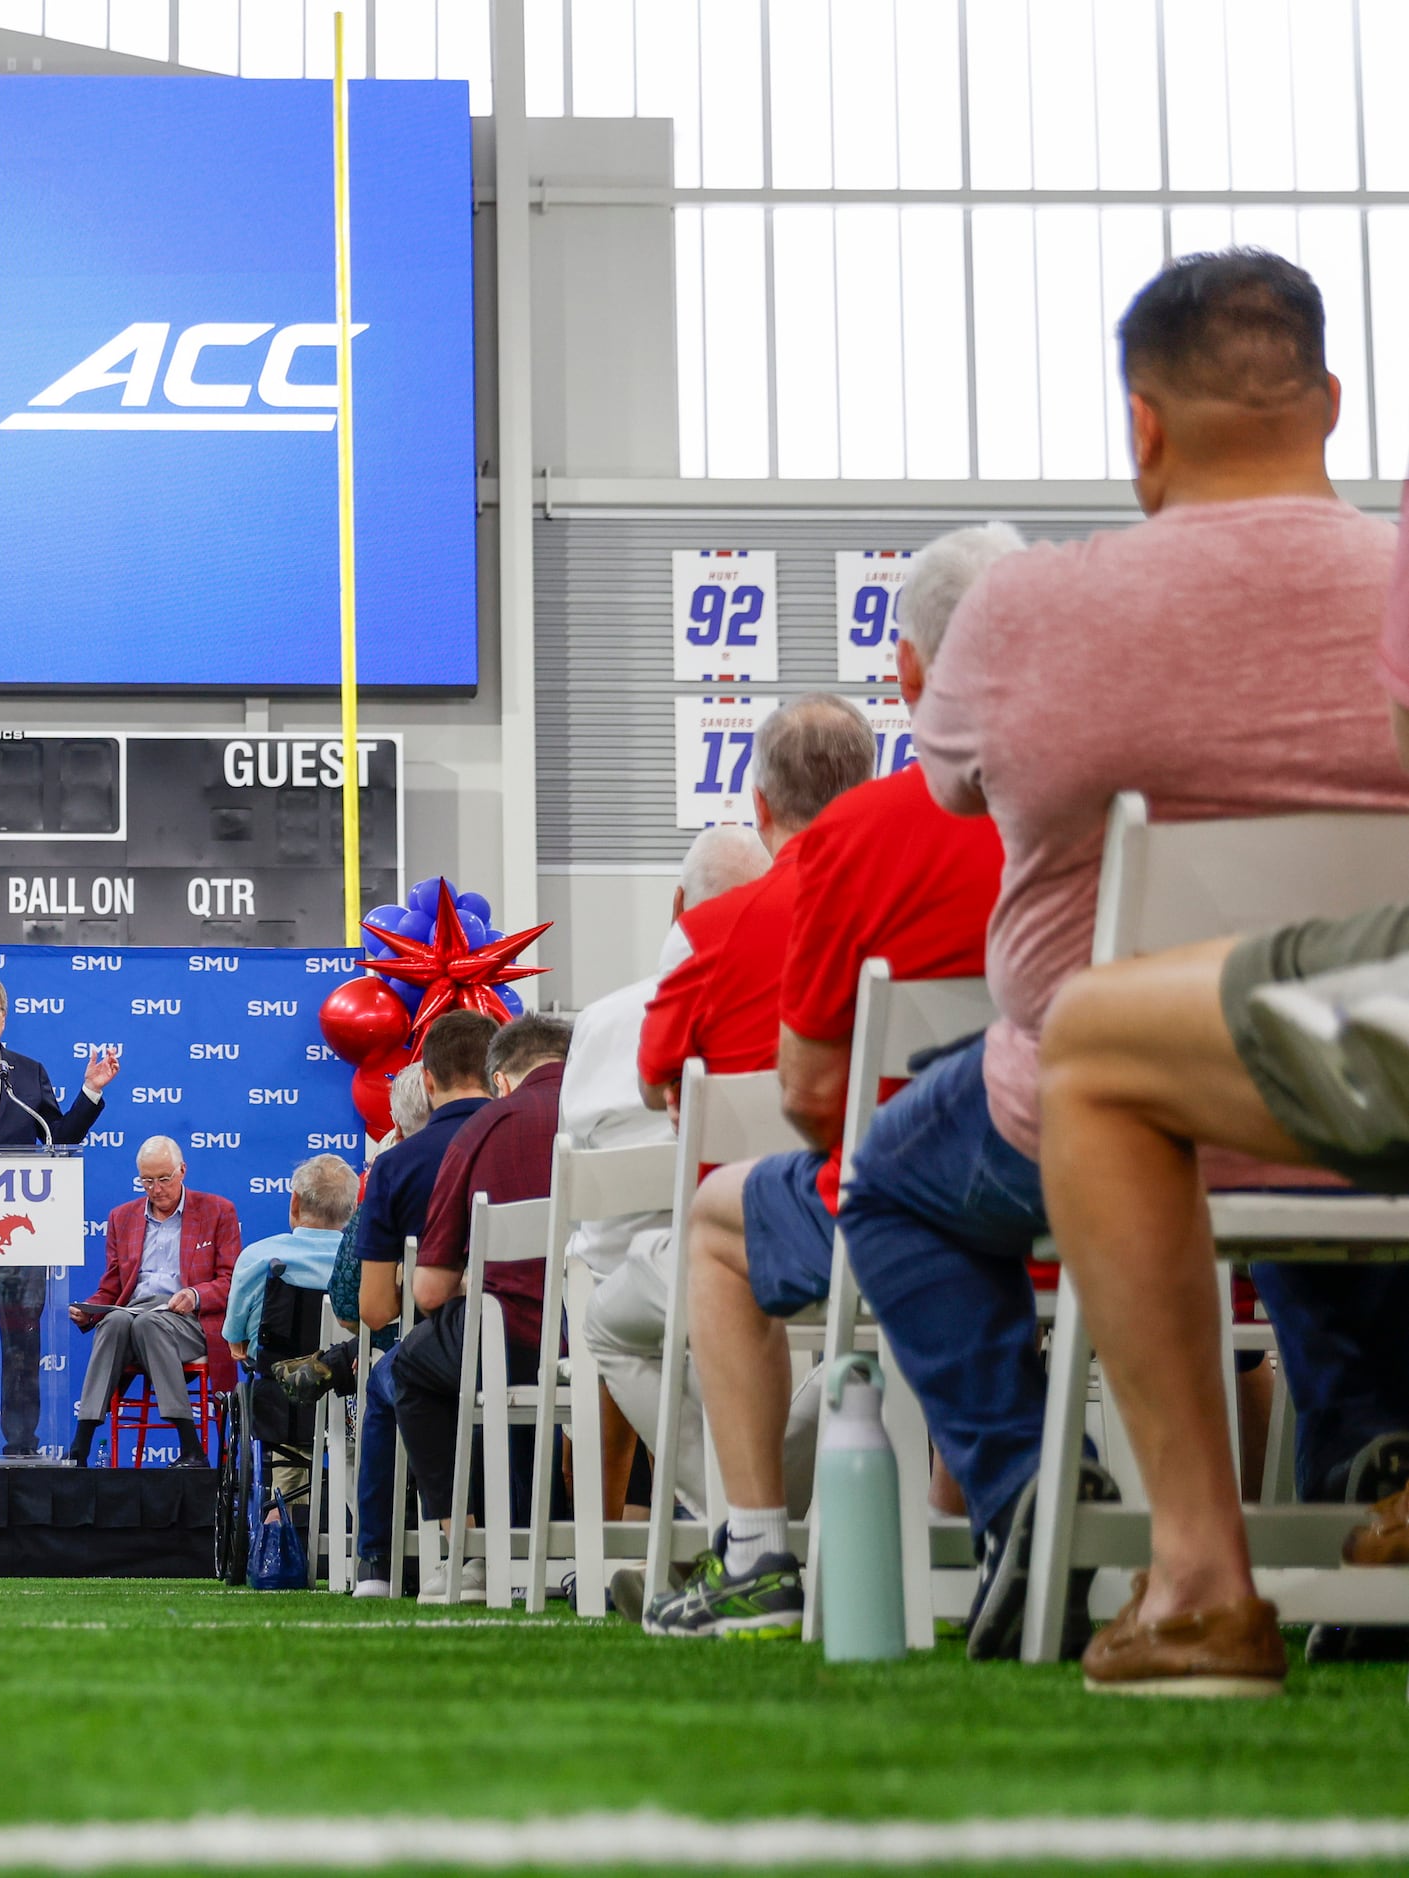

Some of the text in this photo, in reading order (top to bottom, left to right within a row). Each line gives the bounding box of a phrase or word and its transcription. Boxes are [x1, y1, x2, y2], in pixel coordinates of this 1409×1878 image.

[27, 322, 371, 407] ACC
[709, 571, 739, 581] HUNT
[686, 585, 764, 646] 92
[850, 586, 901, 647] 9
[700, 718, 753, 728] SANDERS
[224, 740, 377, 788] GUEST
[694, 732, 755, 794] 17
[8, 877, 134, 915] BALL ON
[187, 877, 256, 918] QTR
[72, 956, 122, 971] SMU
[189, 956, 239, 972] SMU
[306, 958, 356, 973] SMU
[15, 998, 64, 1014] SMU
[131, 999, 181, 1015] SMU
[247, 1001, 298, 1016] SMU
[73, 1043, 123, 1058] SMU
[190, 1044, 239, 1060] SMU
[306, 1045, 340, 1061] SM
[132, 1088, 182, 1103] SMU
[249, 1089, 298, 1104] SMU
[191, 1132, 240, 1148] SMU
[307, 1134, 358, 1149] SMU
[132, 1447, 181, 1463] SMU
